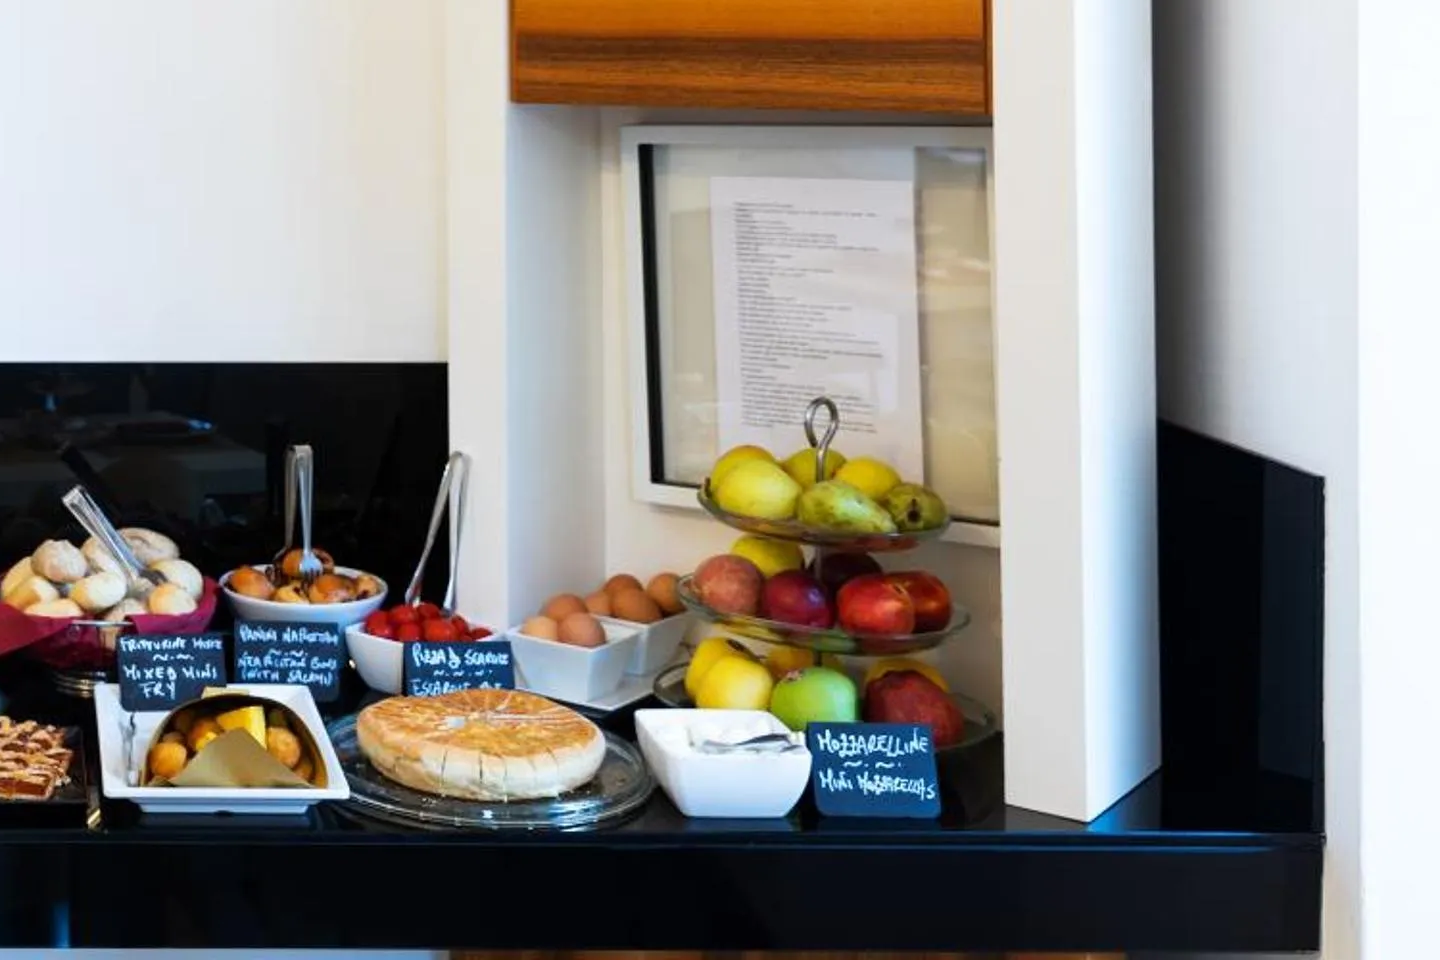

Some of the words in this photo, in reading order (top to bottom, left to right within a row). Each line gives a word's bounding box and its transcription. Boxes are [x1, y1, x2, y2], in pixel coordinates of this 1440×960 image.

[412, 642, 446, 667] PIZZA
[123, 664, 177, 680] MIXED
[182, 663, 217, 679] MINI
[139, 681, 175, 700] FRY
[817, 727, 929, 759] MOZZARELLINE
[819, 767, 853, 792] MINI
